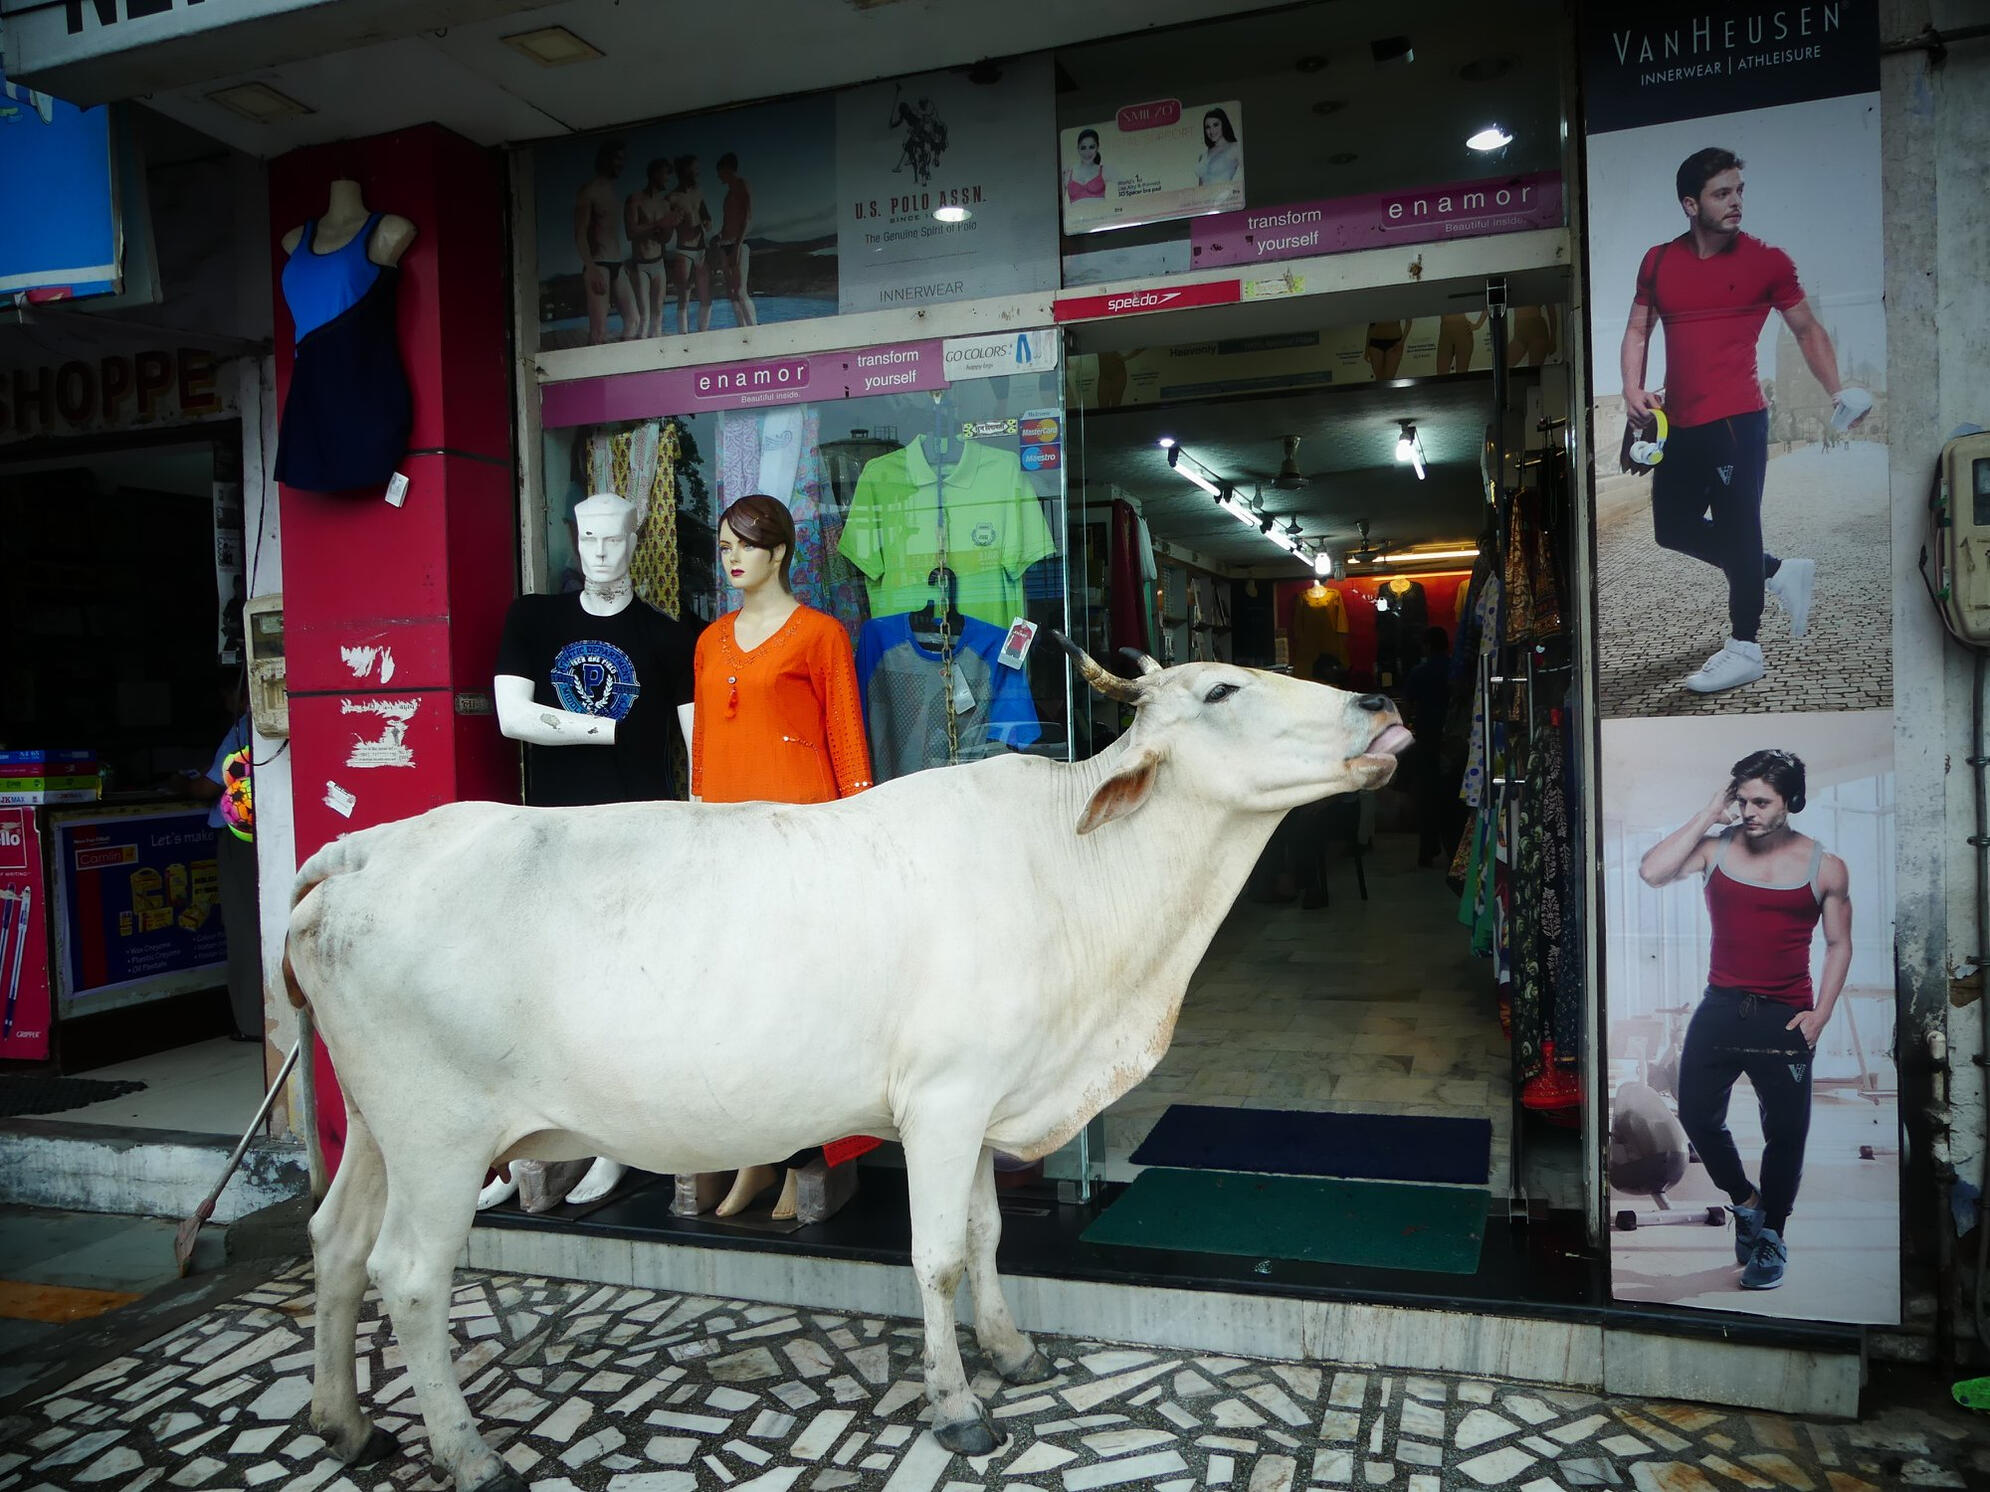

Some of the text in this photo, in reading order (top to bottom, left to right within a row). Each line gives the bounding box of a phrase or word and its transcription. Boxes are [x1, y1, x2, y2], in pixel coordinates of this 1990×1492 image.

[1640, 45, 1822, 86] INNERWEAR ATHLEISURE
[855, 185, 987, 219] U.S. POLO ASSN.
[1389, 184, 1531, 220] enamor
[1247, 208, 1322, 230] transform
[1445, 215, 1527, 233] Beautiful inside.
[865, 234, 881, 245] The
[884, 229, 918, 242] Genuine
[921, 224, 944, 238] Spirit
[1257, 231, 1319, 255] yourself
[880, 281, 964, 303] INNERWEAR
[1108, 293, 1158, 313] speedo
[857, 349, 919, 367] transform
[945, 351, 963, 363] GO
[699, 363, 805, 391] enamor
[864, 371, 917, 390] yourself
[0, 348, 222, 431] HOPPE
[741, 393, 772, 403] Beautiful
[1022, 427, 1058, 438] MasterCard
[1025, 453, 1056, 463] Maestro
[583, 664, 605, 698] P
[151, 829, 215, 847] Let's make
[79, 850, 121, 866] Camlin
